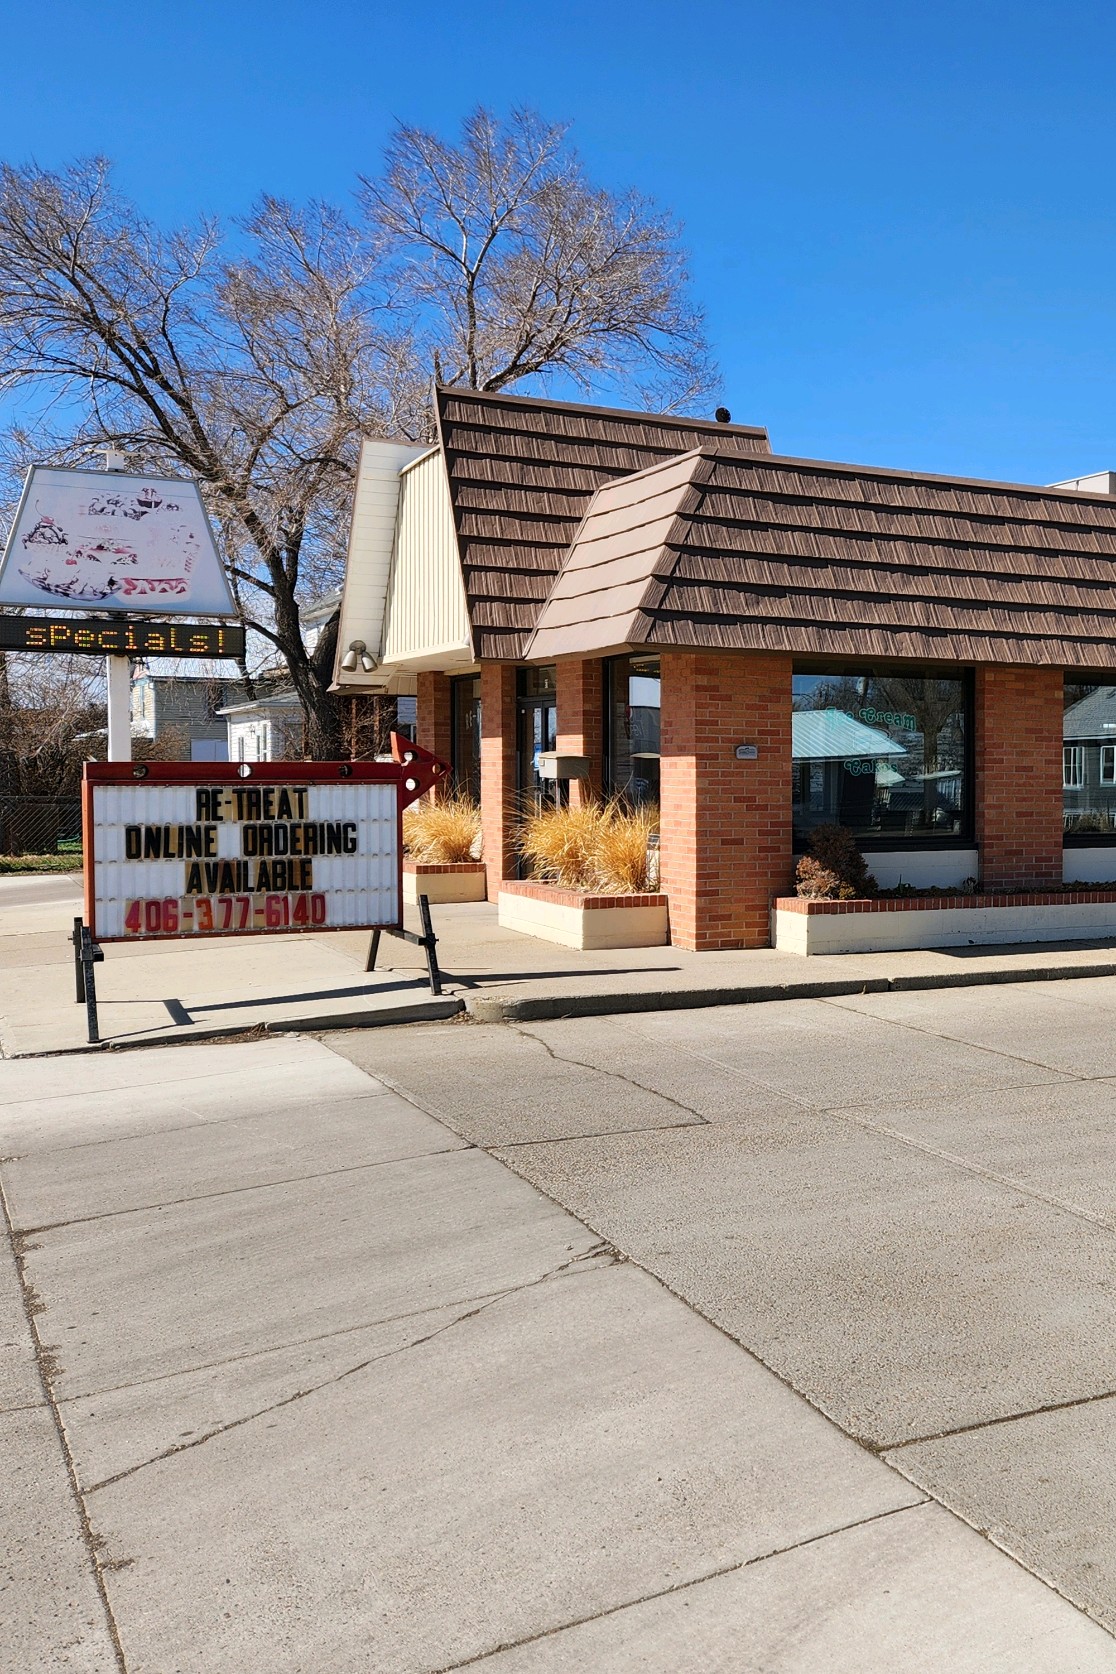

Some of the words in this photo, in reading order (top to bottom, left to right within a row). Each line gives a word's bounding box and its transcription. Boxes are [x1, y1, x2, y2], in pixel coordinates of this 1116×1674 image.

[859, 707, 917, 732] Cream
[843, 758, 898, 776] Cakes
[196, 788, 308, 821] RE-TREAT
[125, 825, 217, 860] ONLINE
[242, 823, 357, 856] ORDERING
[186, 859, 312, 893] AVAILABLE
[124, 893, 326, 933] 406-377-6140
